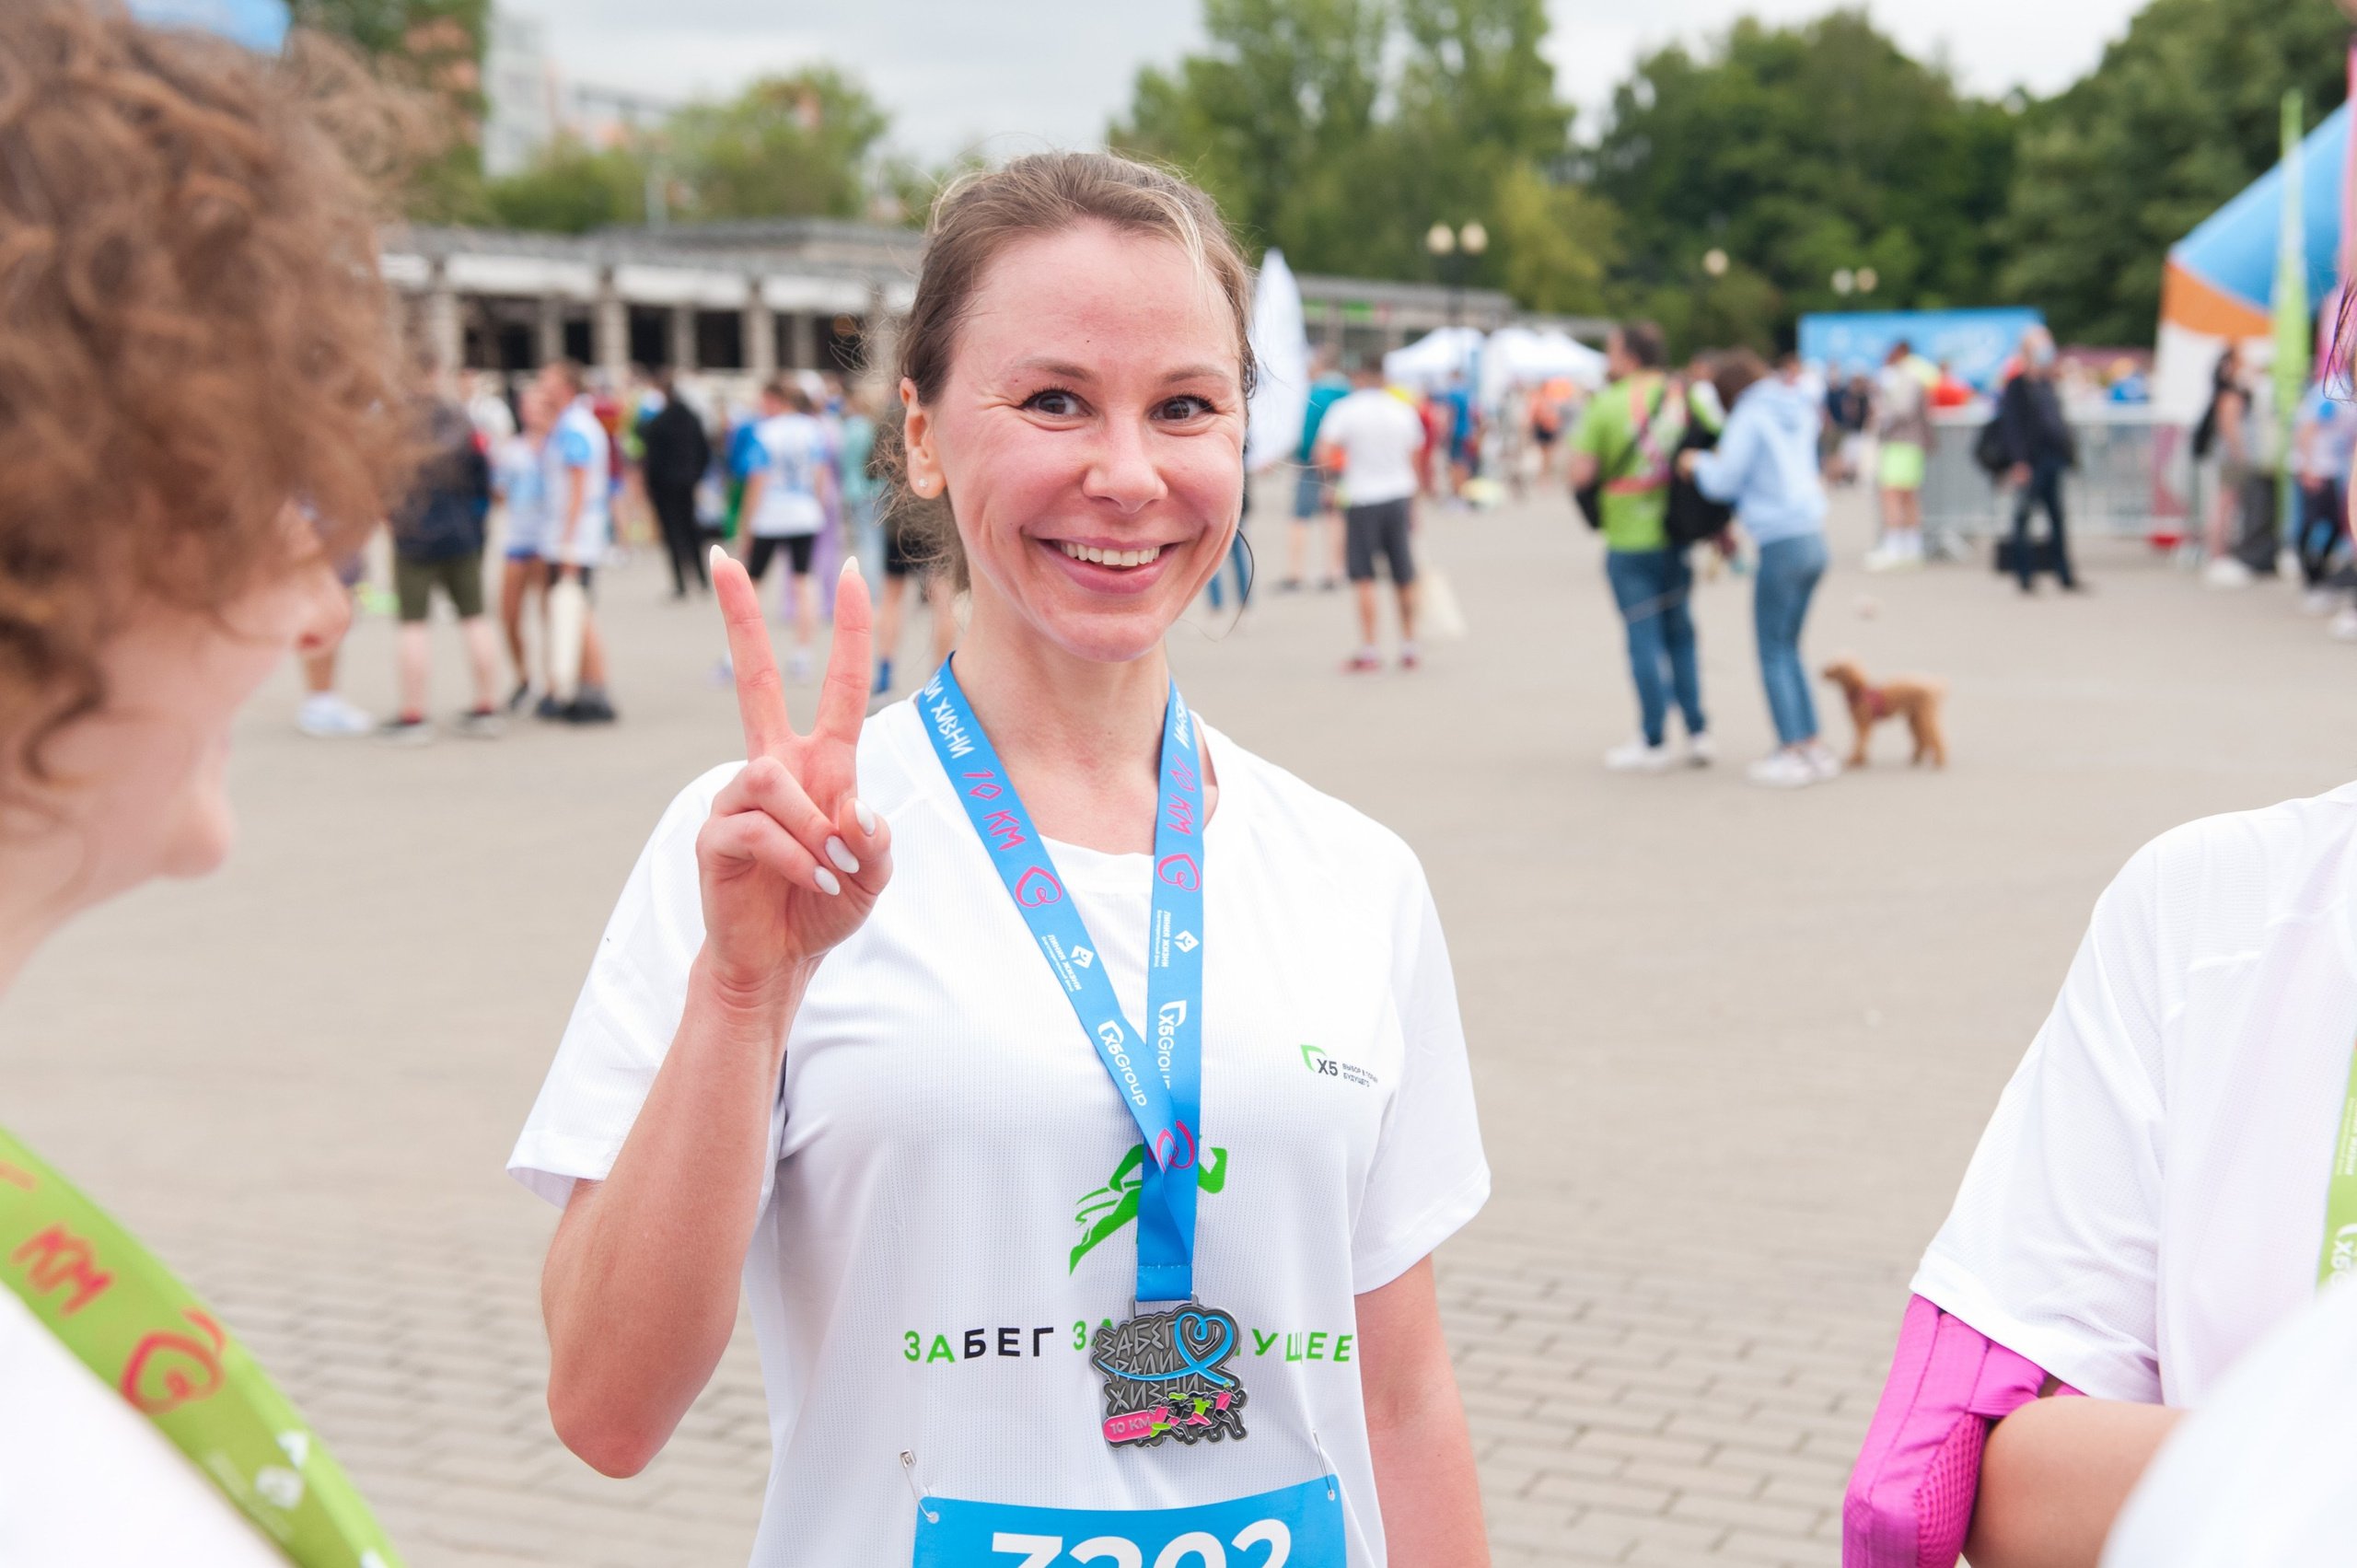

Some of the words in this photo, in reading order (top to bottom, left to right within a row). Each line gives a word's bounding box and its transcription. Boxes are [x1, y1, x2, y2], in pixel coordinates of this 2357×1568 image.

[962, 767, 1004, 800] 10
[1169, 754, 1195, 792] 10
[1101, 1033, 1147, 1106] X5Group
[1317, 1058, 1338, 1076] X5
[903, 1326, 1054, 1364] ЗАБЕГ
[1100, 1320, 1176, 1360] ЗАБЕГ
[1109, 1373, 1199, 1413] ЖИЗНИ
[1109, 1422, 1126, 1434] 10
